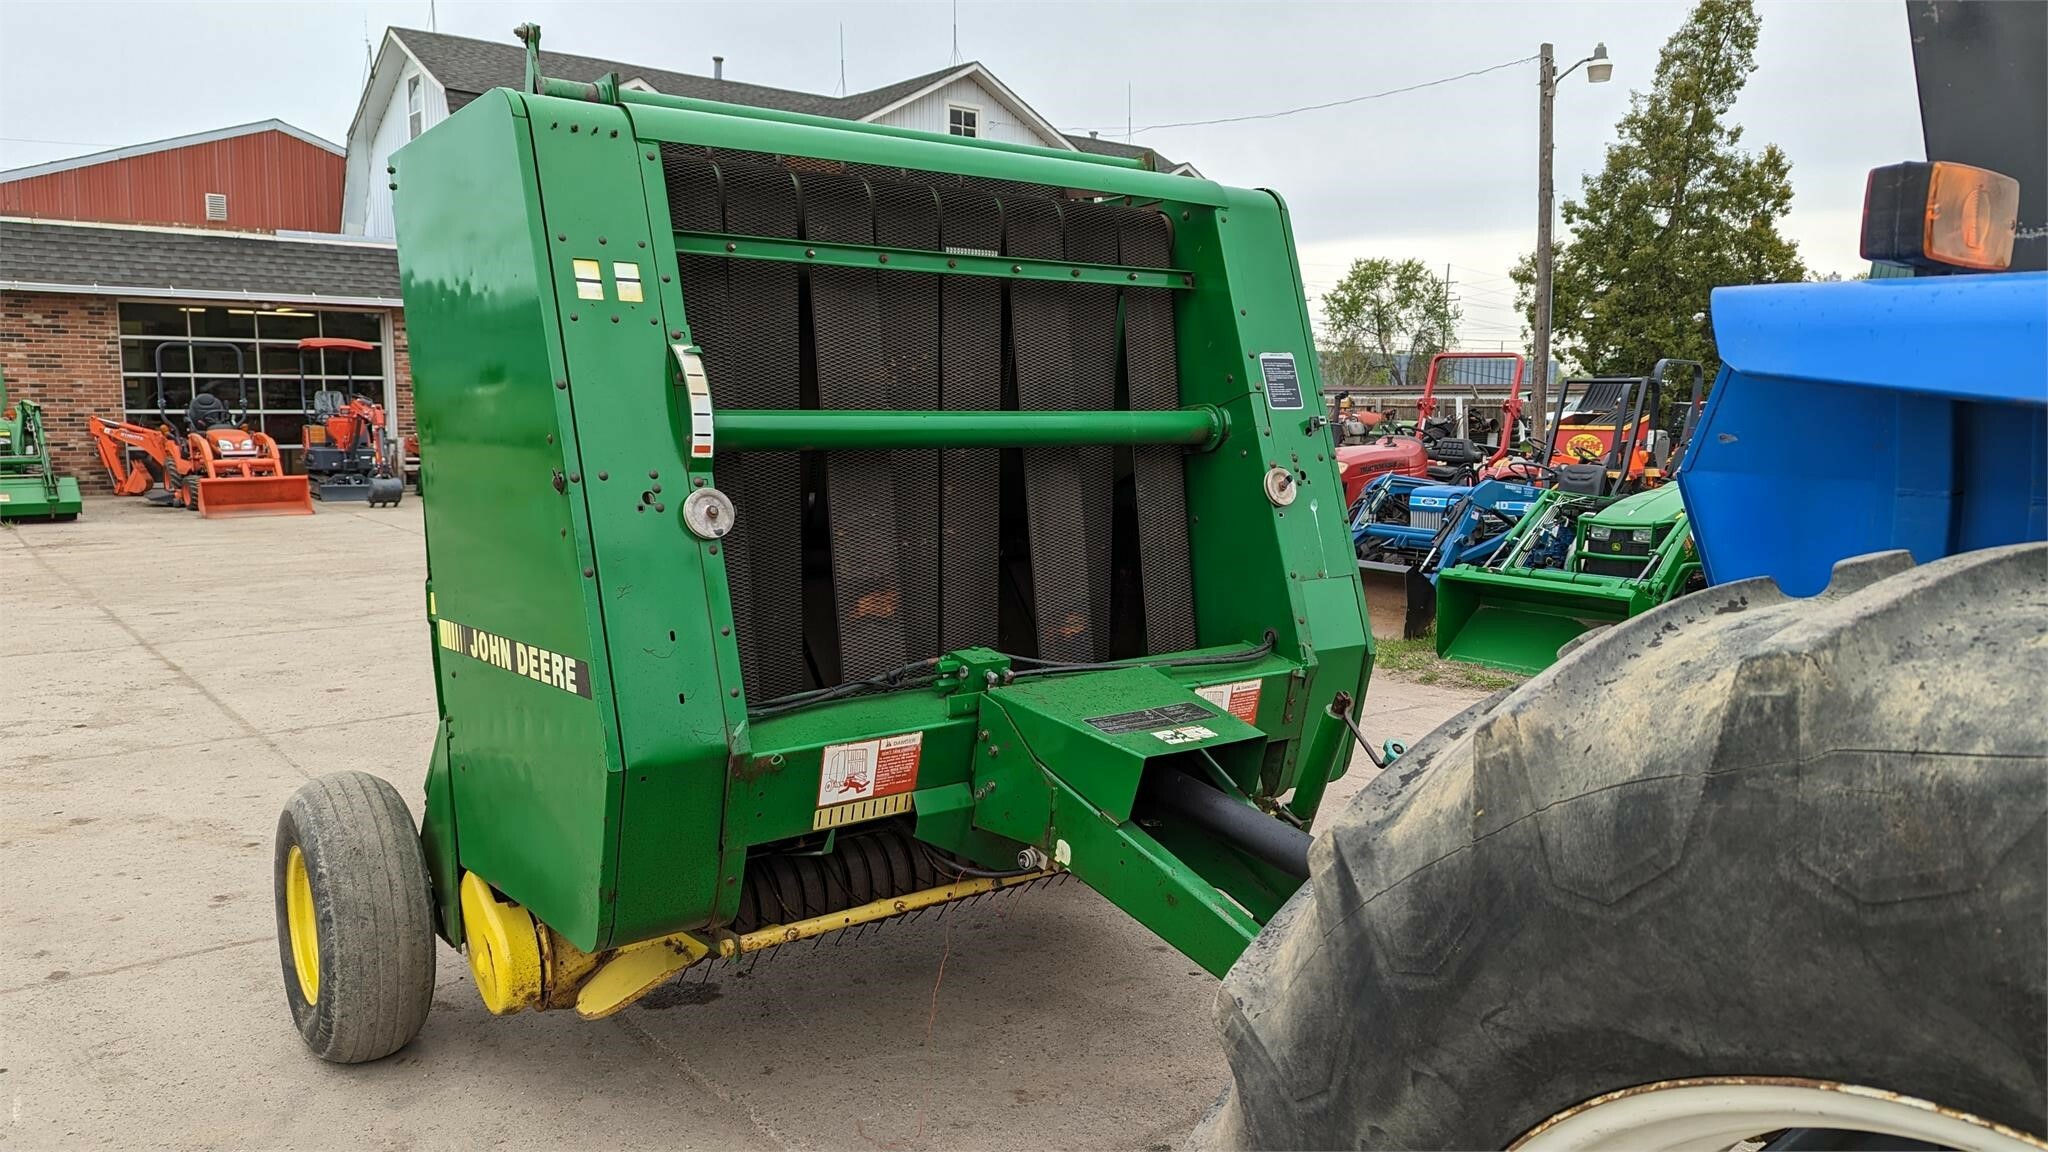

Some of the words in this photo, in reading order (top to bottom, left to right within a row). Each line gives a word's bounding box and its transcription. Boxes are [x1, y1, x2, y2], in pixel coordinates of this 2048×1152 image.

[470, 629, 512, 671] JOHN
[516, 642, 577, 693] DEERE
[893, 738, 916, 746] DANGER
